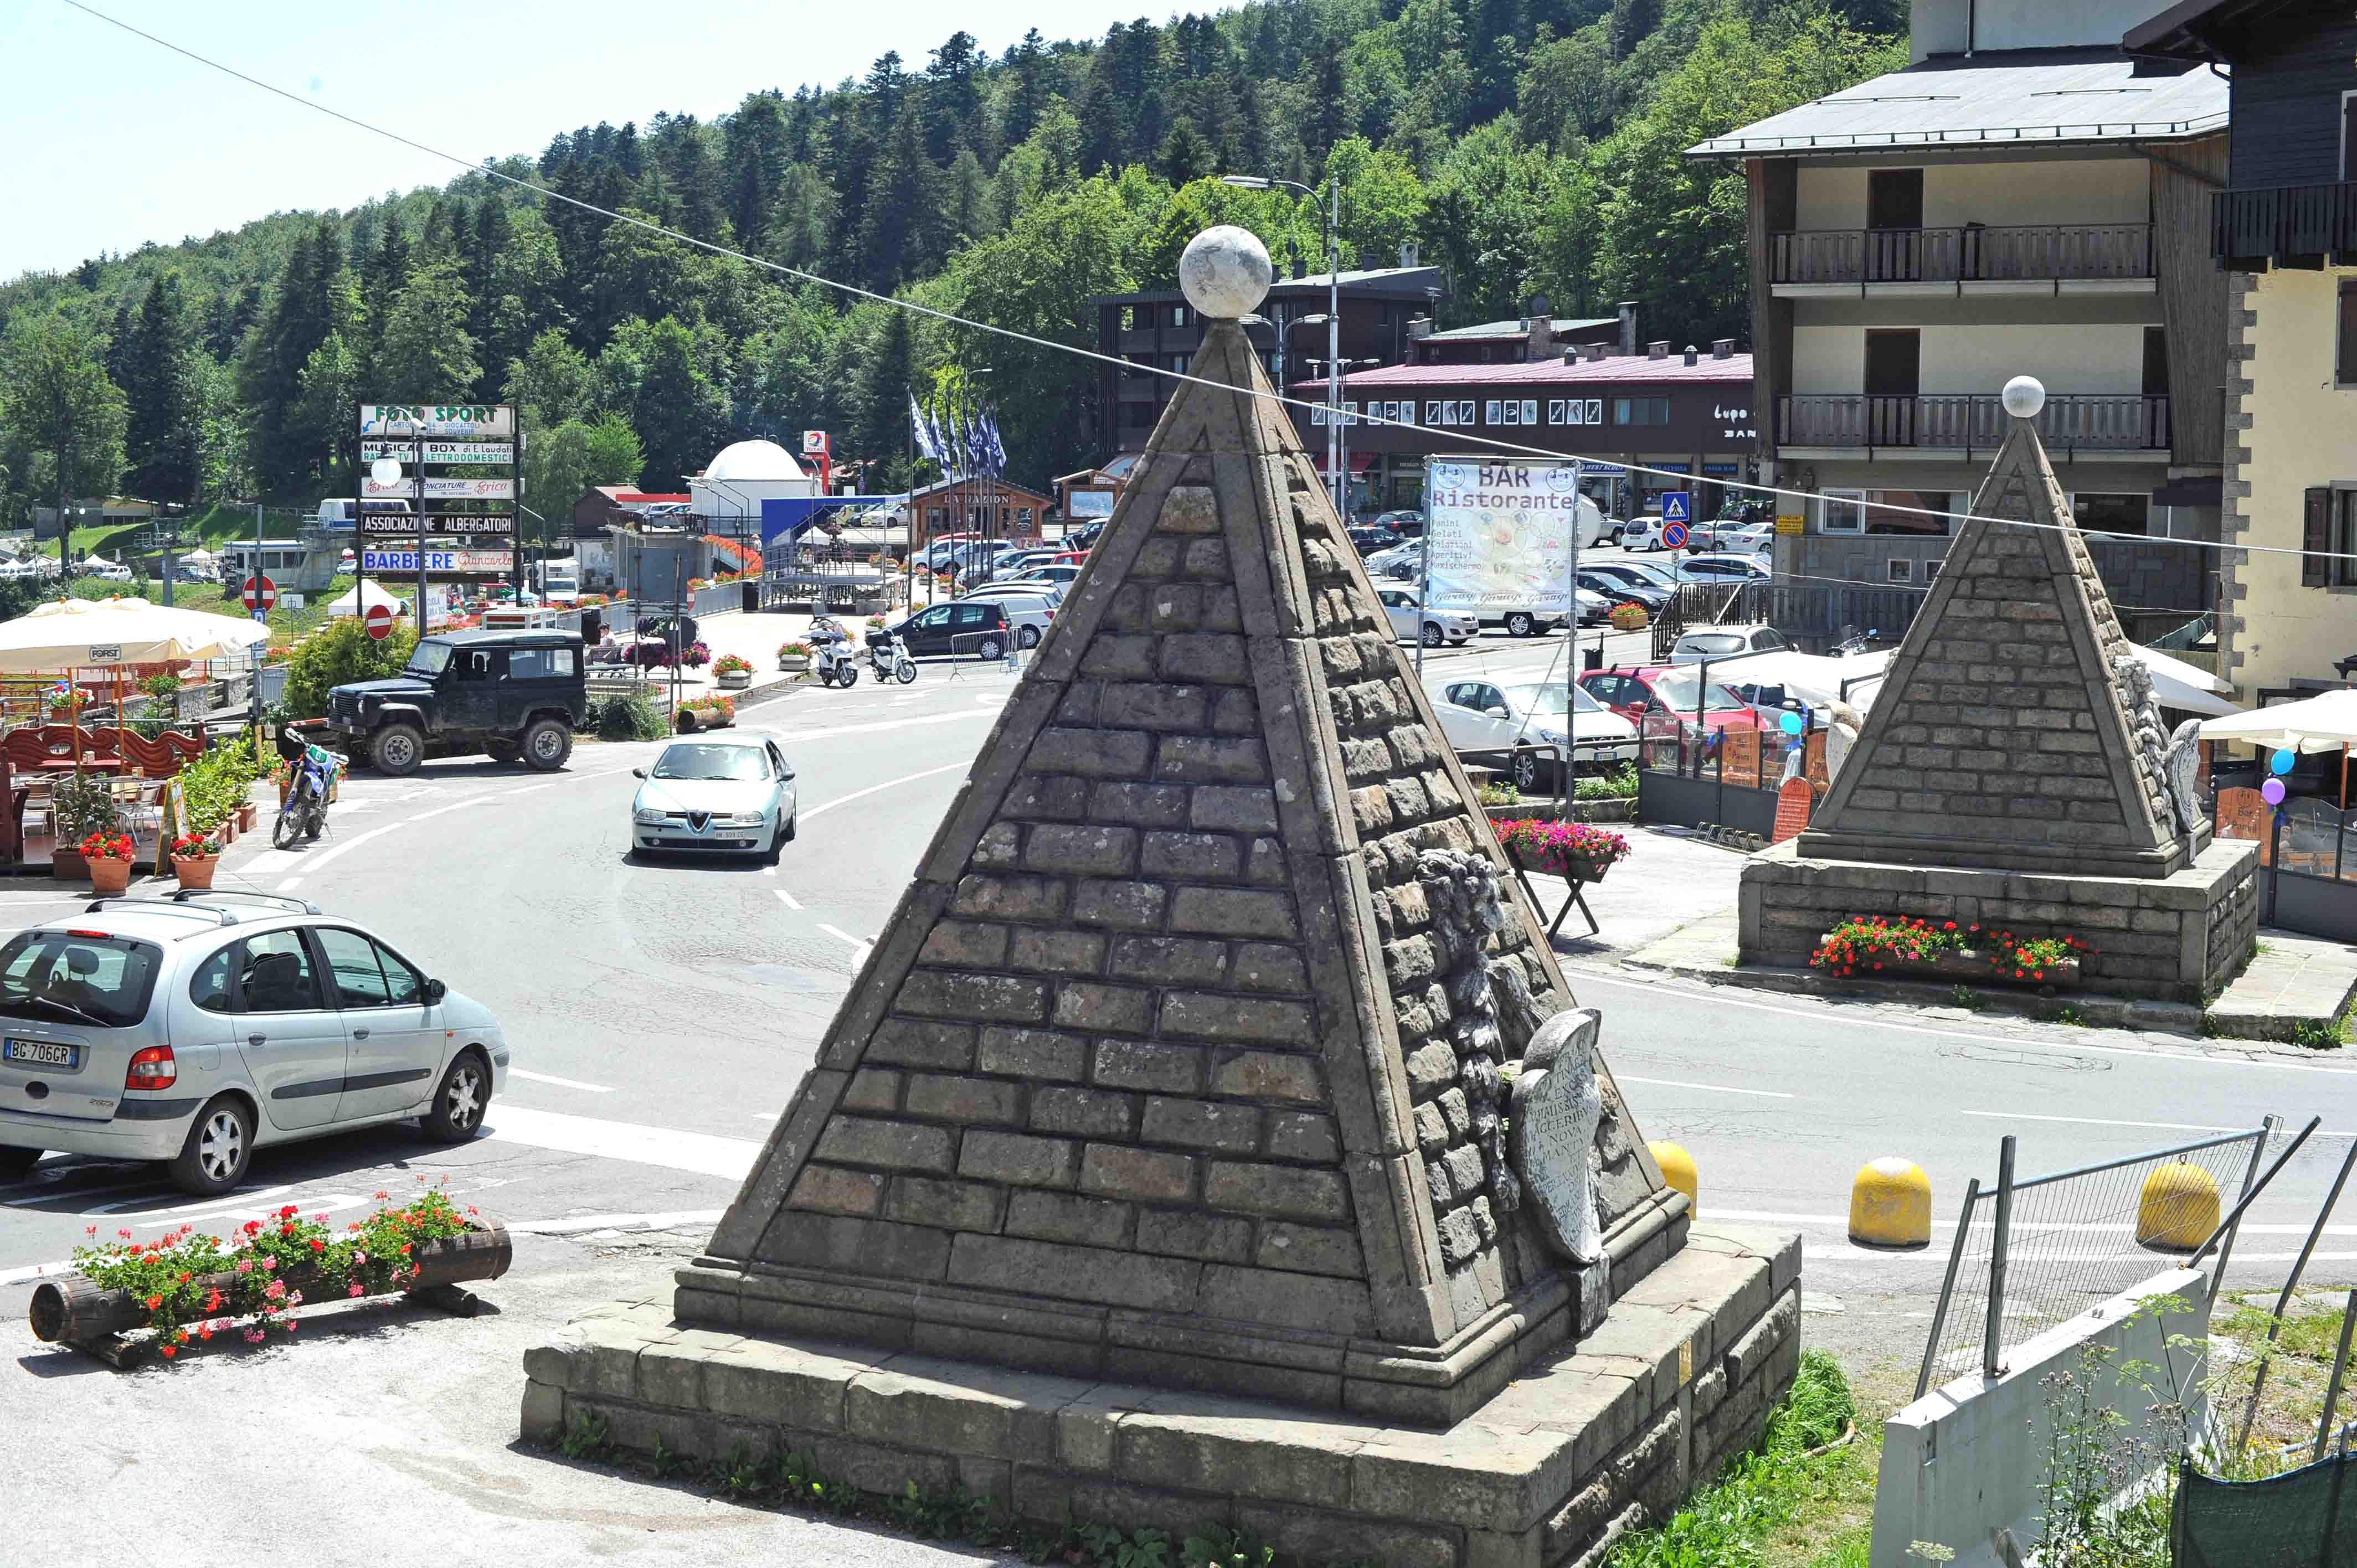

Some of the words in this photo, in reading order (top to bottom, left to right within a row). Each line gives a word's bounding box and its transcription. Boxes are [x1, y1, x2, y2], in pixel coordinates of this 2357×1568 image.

[375, 407, 425, 421] FOTO
[435, 407, 497, 424] SPORT
[1479, 466, 1531, 487] BAR
[474, 482, 507, 494] Erica
[1433, 490, 1573, 509] Ristorante
[364, 517, 435, 531] ASSOCIAZINE
[445, 518, 511, 532] ALBERGATORI
[458, 551, 512, 571] Giancarlo
[13, 1043, 27, 1058] BG
[31, 1045, 68, 1063] 706GR
